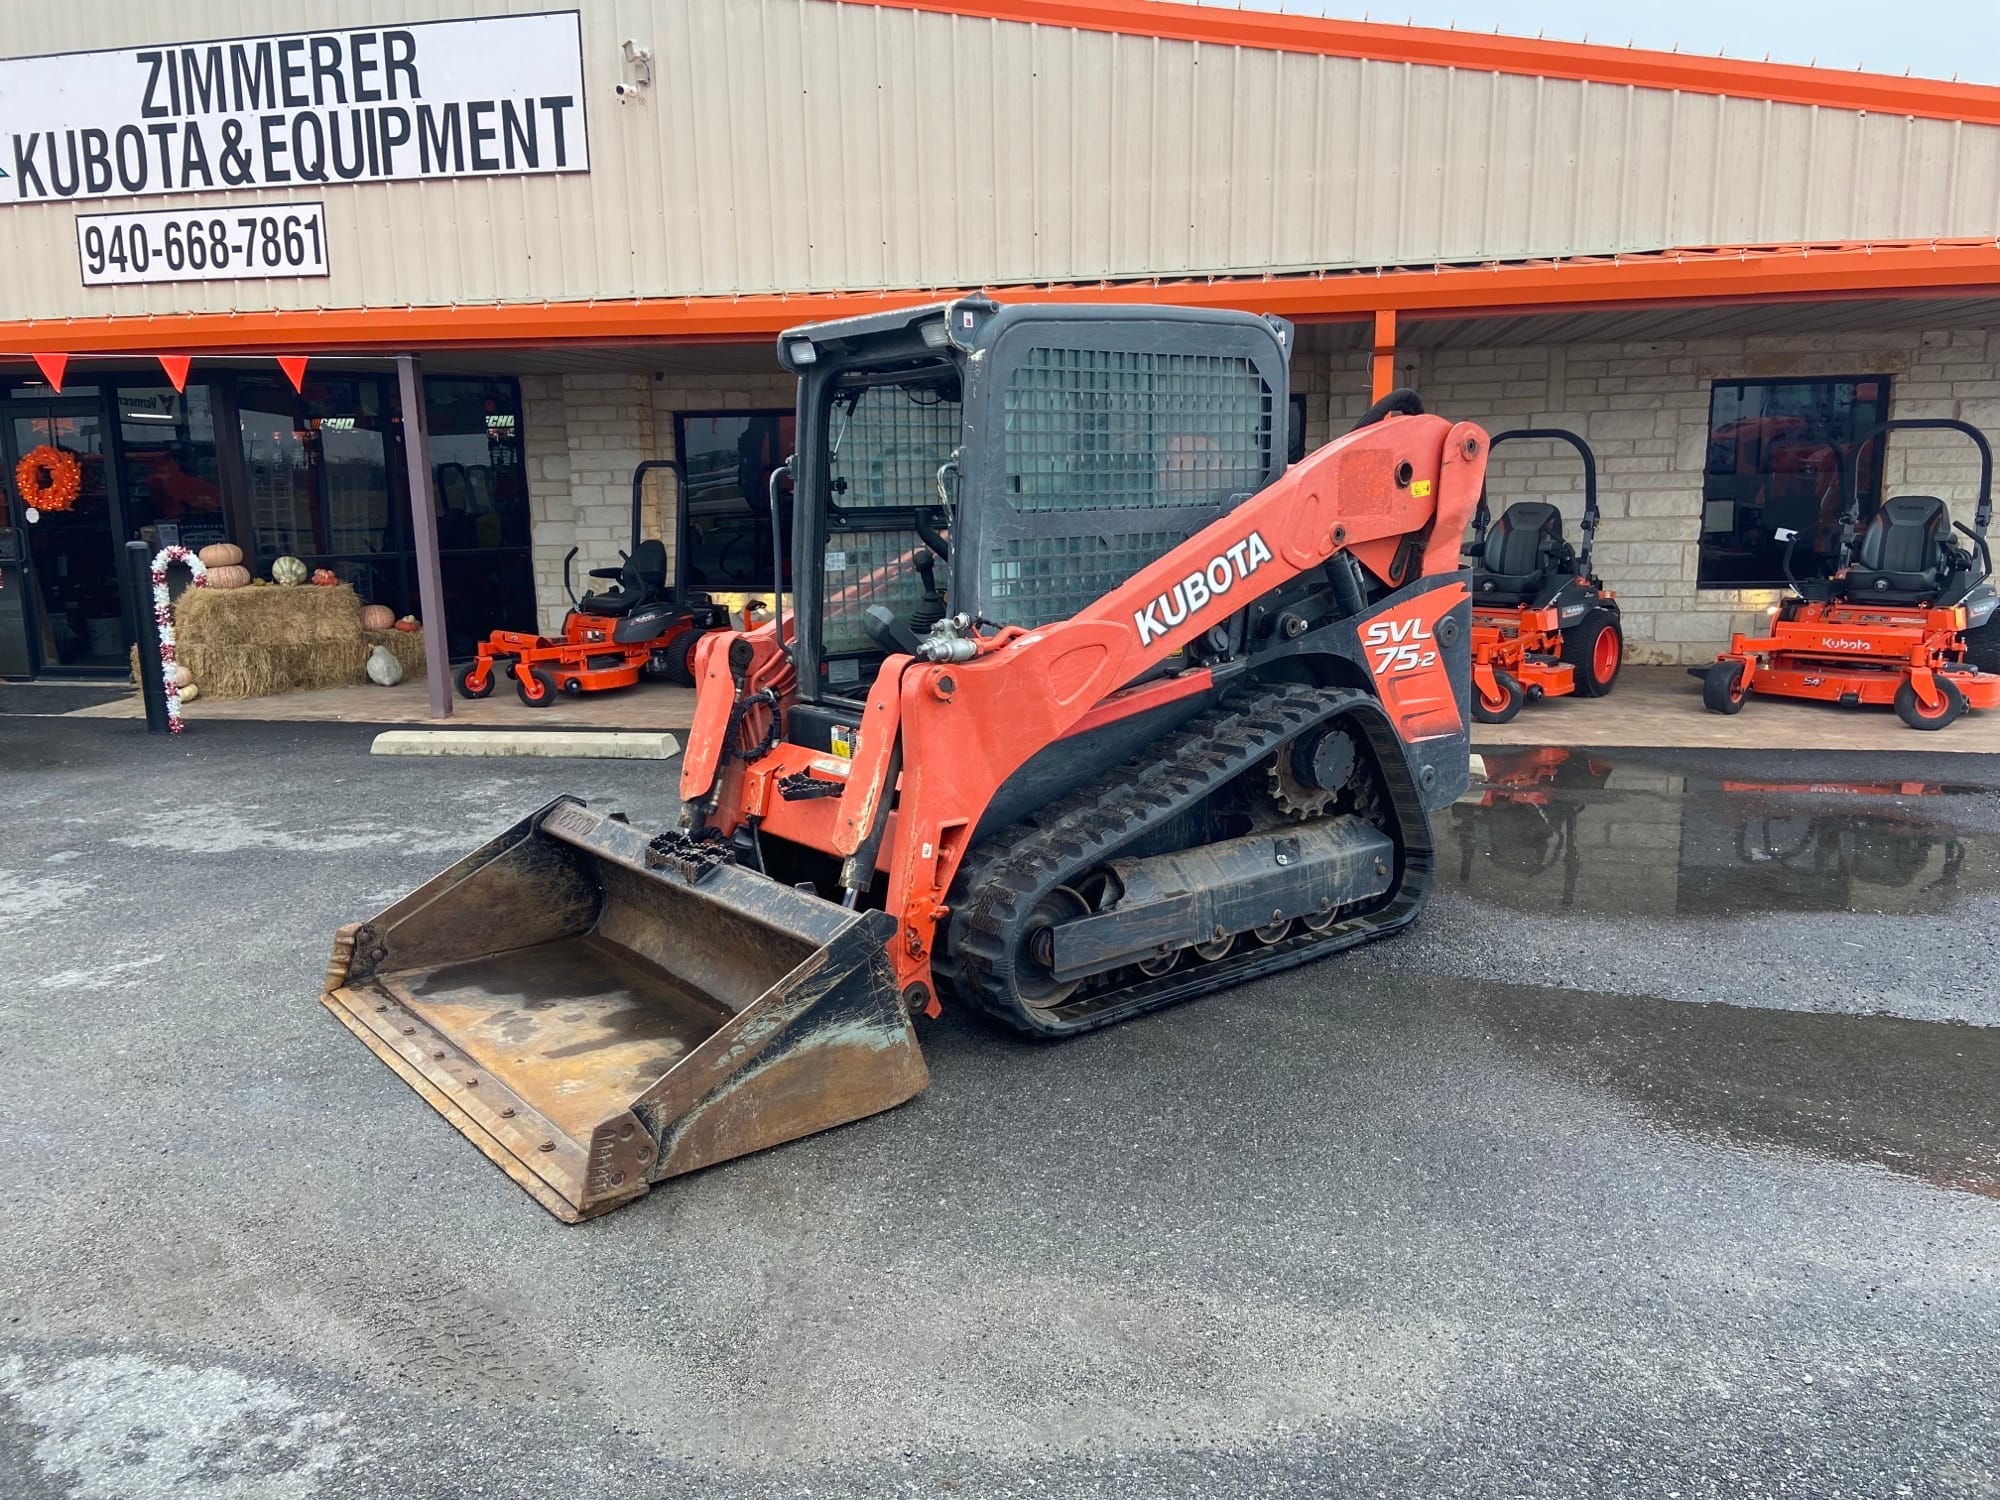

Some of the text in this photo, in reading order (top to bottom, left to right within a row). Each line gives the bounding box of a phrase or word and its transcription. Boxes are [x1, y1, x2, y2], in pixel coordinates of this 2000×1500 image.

[136, 30, 422, 119] ZIMMERER
[85, 213, 322, 275] 940-668-7861
[1133, 531, 1273, 647] KUBOTA
[1364, 618, 1433, 647] SVL
[1822, 637, 1871, 651] Kubota
[1375, 643, 1437, 675] 75-2
